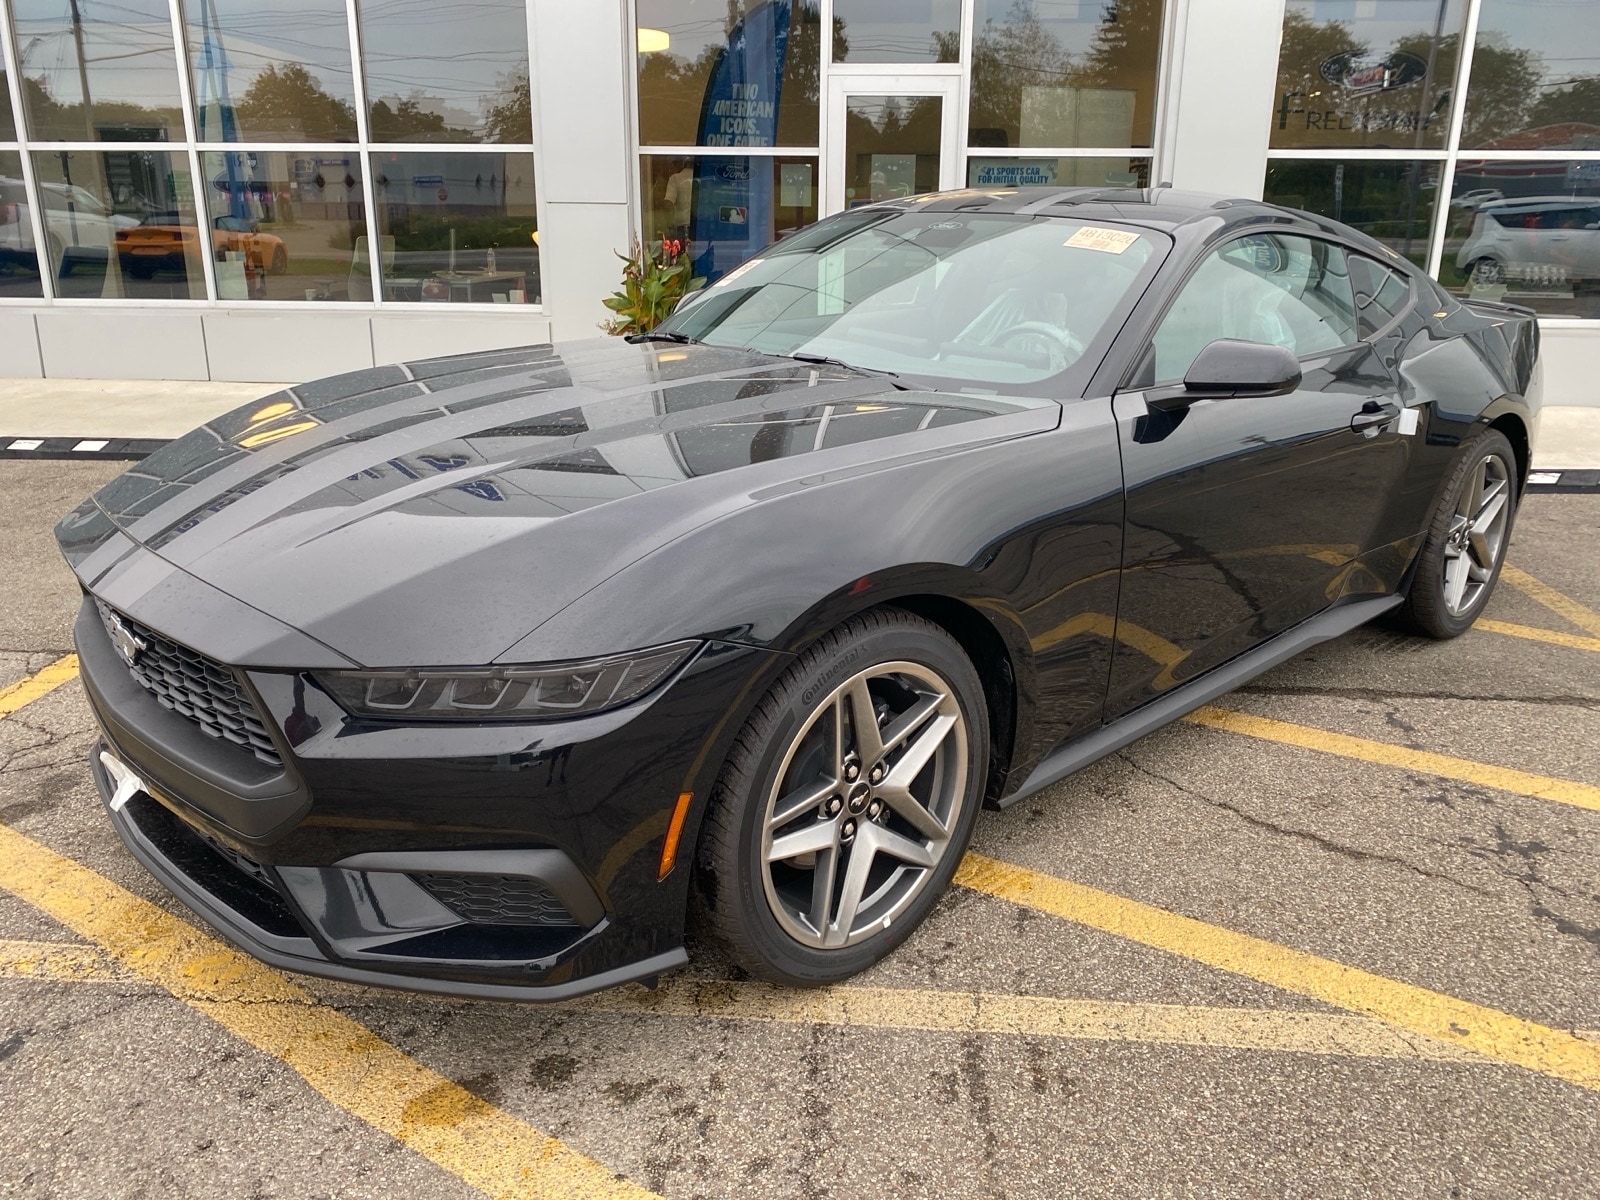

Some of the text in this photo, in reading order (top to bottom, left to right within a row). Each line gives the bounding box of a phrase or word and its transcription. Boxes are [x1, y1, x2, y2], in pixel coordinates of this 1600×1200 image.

[732, 83, 759, 100] TWO
[712, 100, 774, 118] AMERICAN
[720, 118, 760, 134] ICONS.
[706, 134, 732, 147] ONE
[984, 166, 1041, 175] #1 SPORTS CAR
[977, 175, 1049, 186] FOR INITIAL QUALITY
[801, 647, 860, 705] Continental
